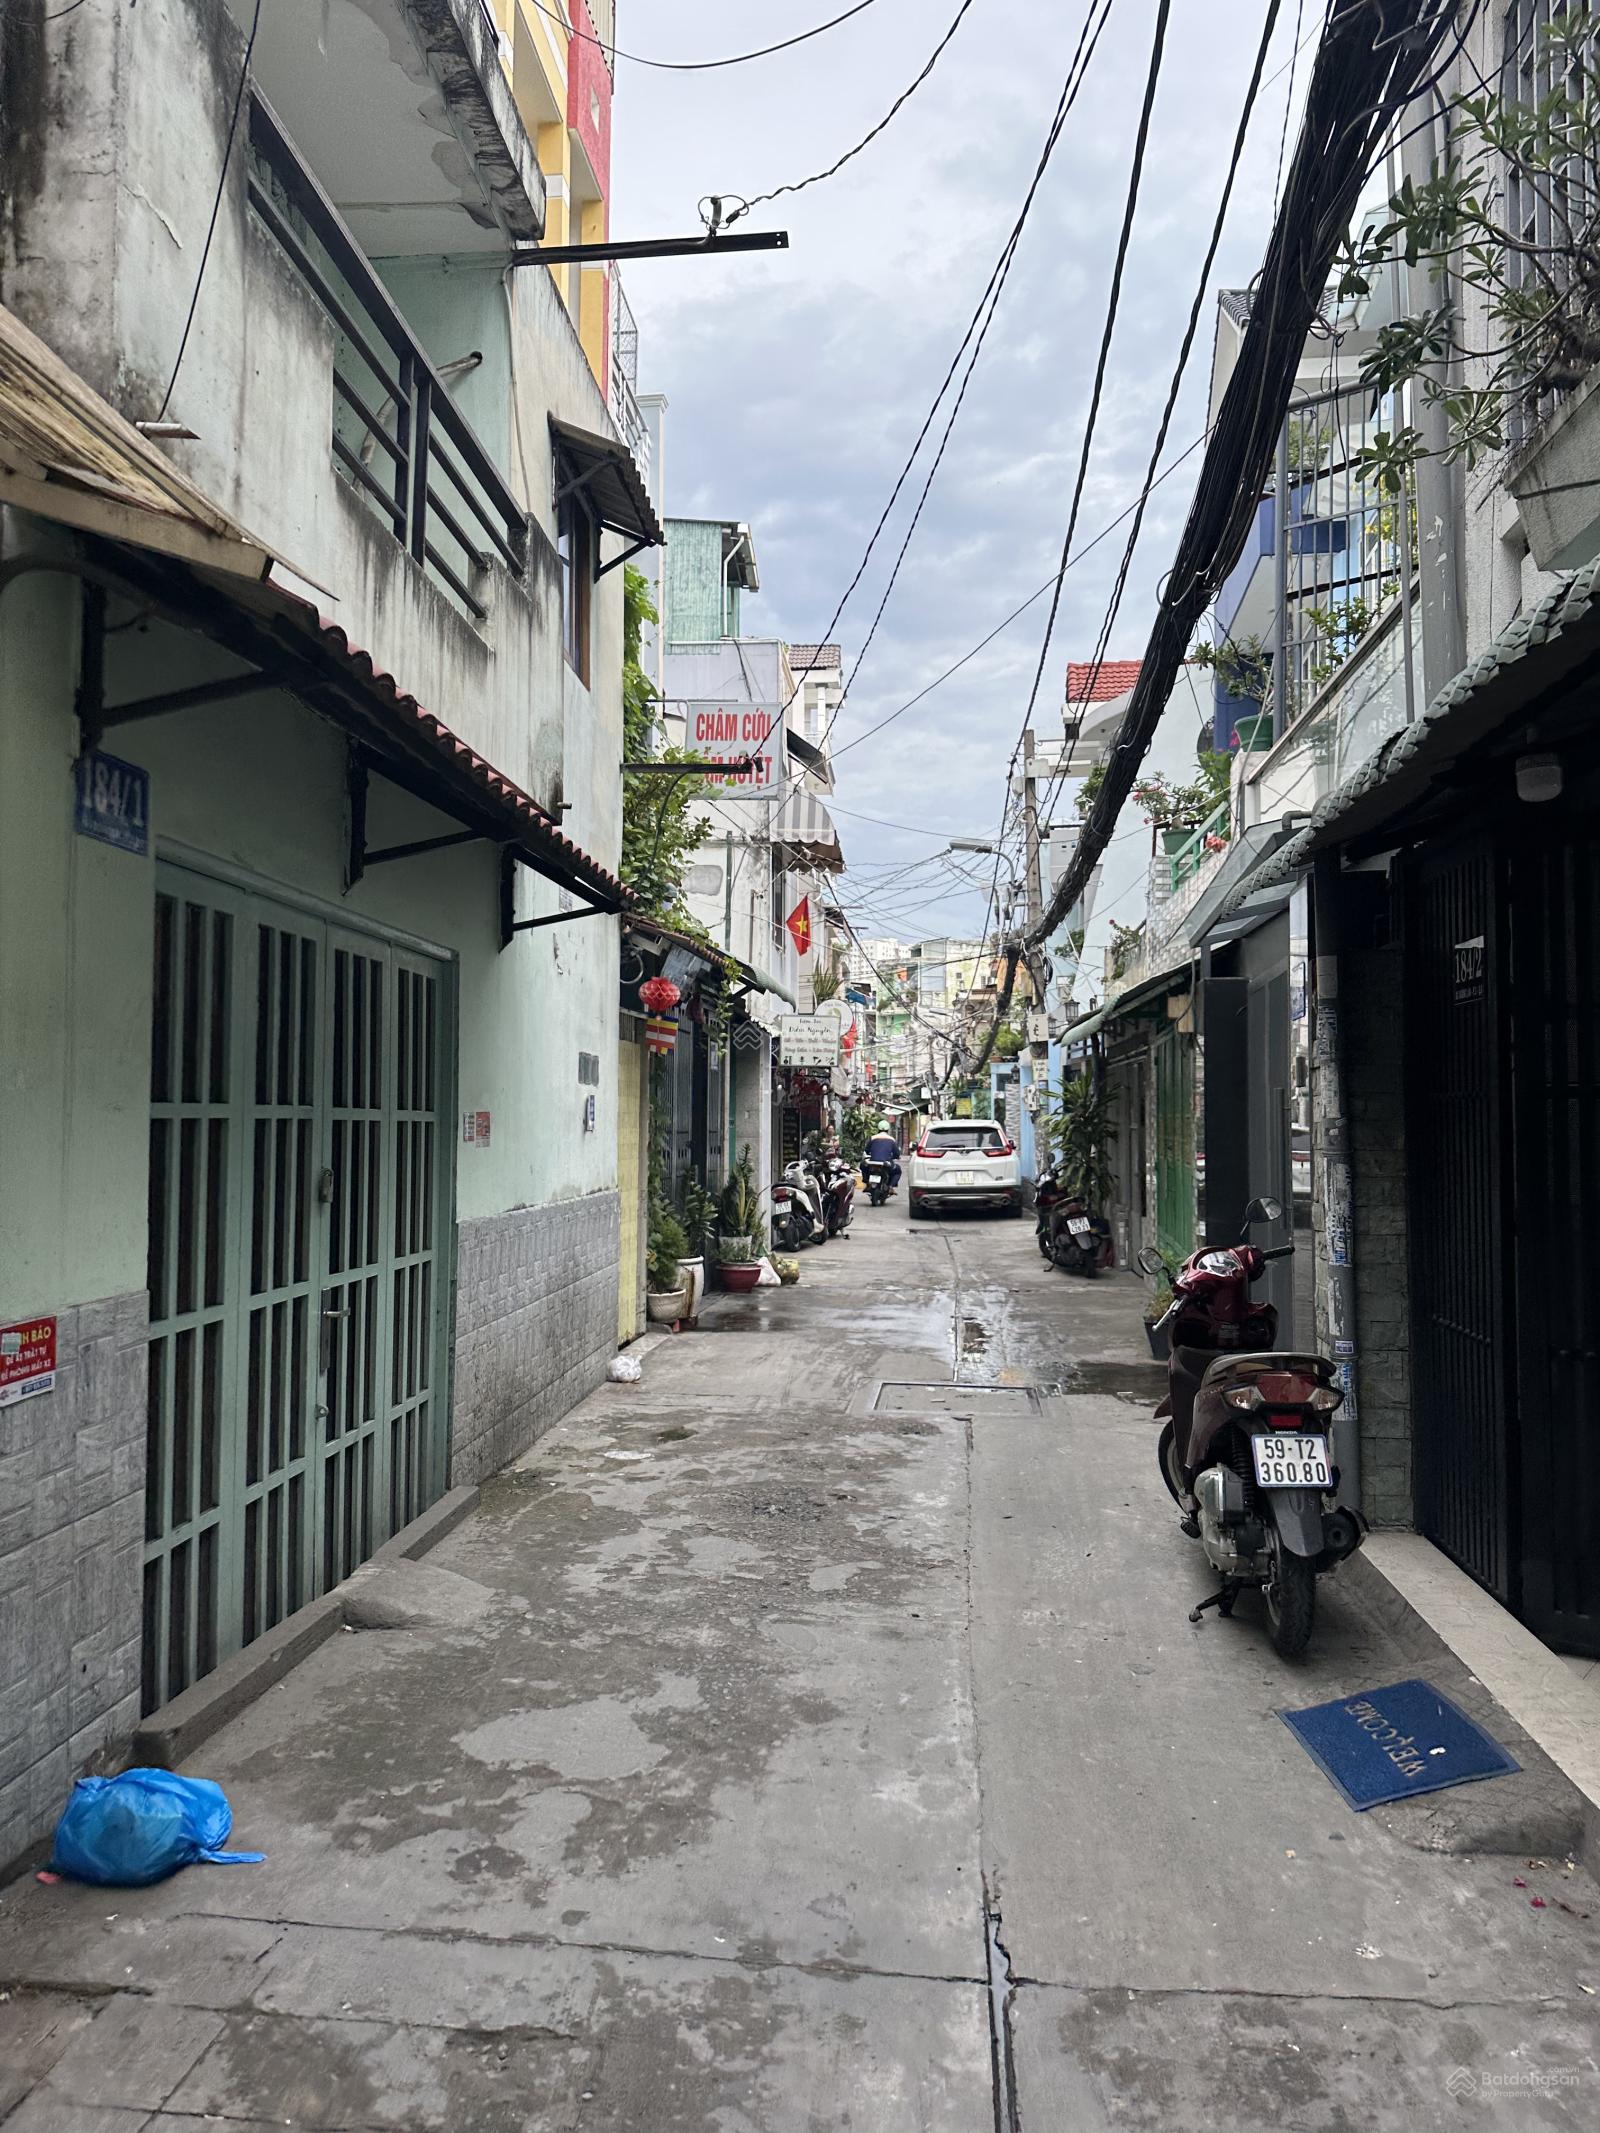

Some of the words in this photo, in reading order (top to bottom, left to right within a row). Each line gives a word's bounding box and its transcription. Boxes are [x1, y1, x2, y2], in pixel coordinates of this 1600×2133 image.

[696, 707, 738, 741] CHÂM
[742, 707, 771, 741] CỨU
[82, 756, 144, 828] 184/1
[1455, 947, 1482, 983] 184/2
[1263, 1438, 1317, 1460] 59-T2
[1260, 1462, 1328, 1483] 360.80
[1344, 1700, 1428, 1777] WELCOME
